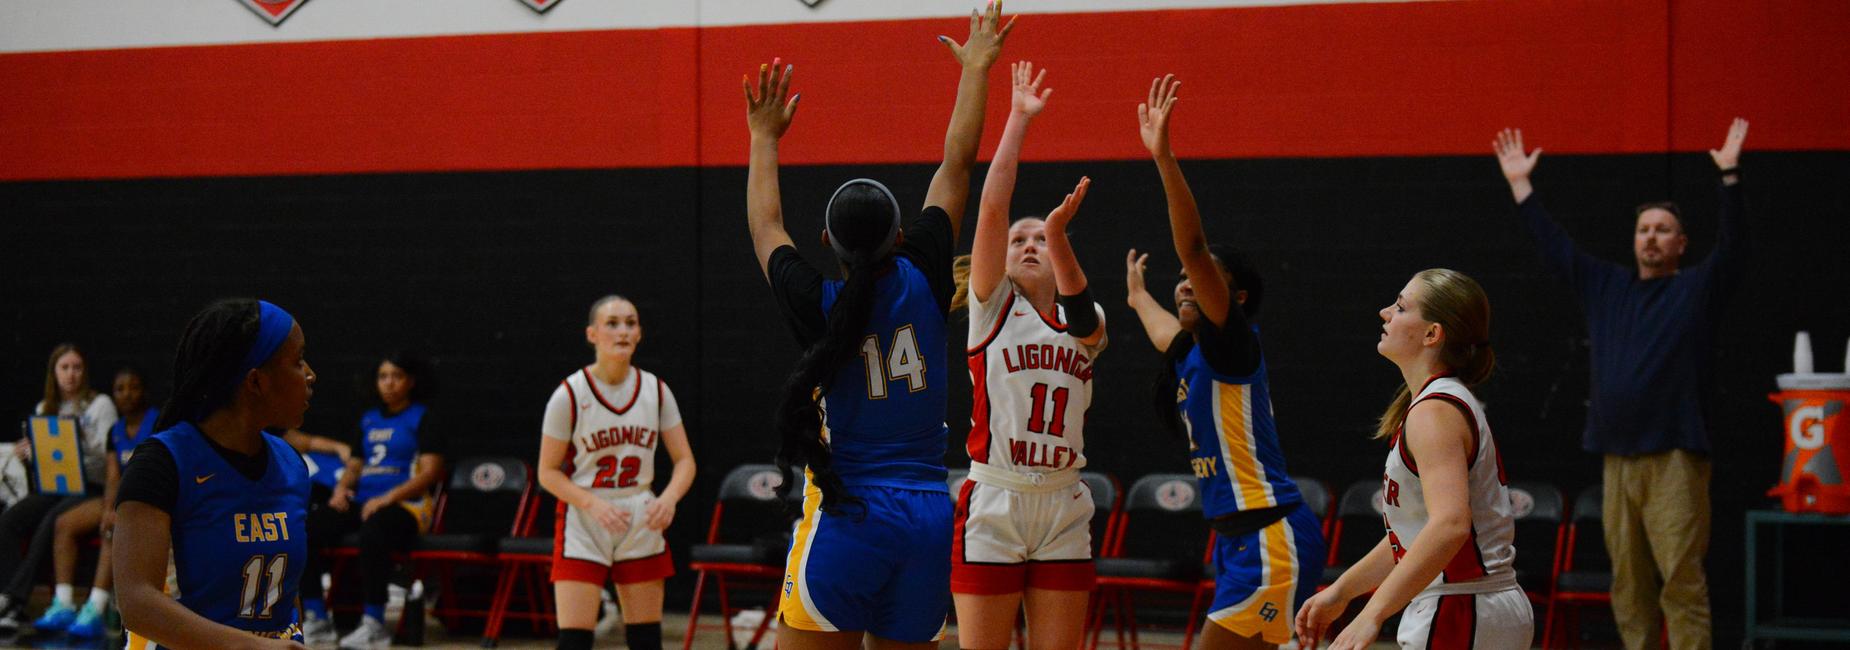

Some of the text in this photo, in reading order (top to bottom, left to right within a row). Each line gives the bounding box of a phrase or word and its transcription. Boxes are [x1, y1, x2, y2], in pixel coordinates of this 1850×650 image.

[857, 323, 928, 400] 14
[1027, 382, 1069, 437] 11
[1790, 405, 1825, 449] G
[592, 455, 641, 488] 22
[1009, 438, 1078, 468] VALLEY
[234, 511, 289, 542] EAST
[238, 552, 288, 619] 11
